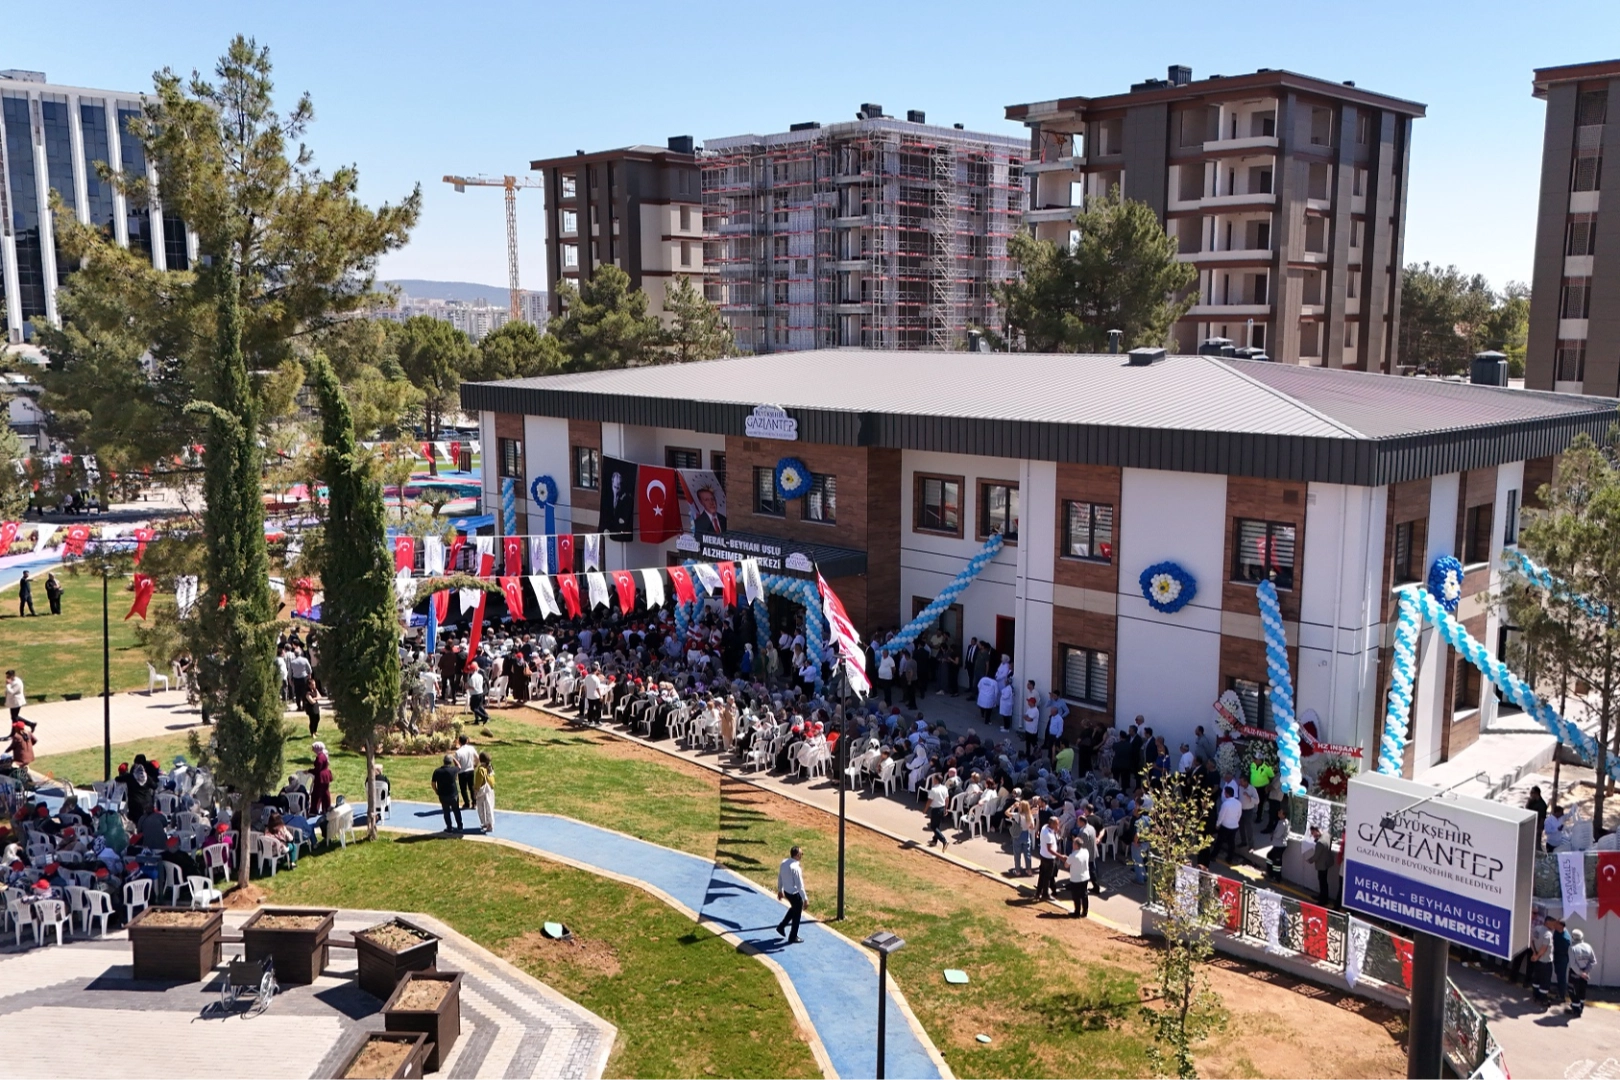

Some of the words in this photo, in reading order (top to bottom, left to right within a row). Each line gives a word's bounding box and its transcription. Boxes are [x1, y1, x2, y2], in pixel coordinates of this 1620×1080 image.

[702, 547, 743, 562] ALZHEIMER
[762, 544, 781, 556] USLU
[1356, 845, 1400, 864] GAZİANTEP
[1401, 857, 1453, 880] BÜYÜKŞEHİR
[1455, 874, 1502, 894] BELEDİYESİ
[1357, 822, 1504, 881] GAZİANTEP
[1354, 876, 1395, 897] MERAL
[1410, 892, 1462, 918] BEYHAN
[1467, 910, 1500, 929] USLU
[1354, 890, 1433, 924] ALZHEIMER
[1434, 914, 1500, 946] MERKEZİ
